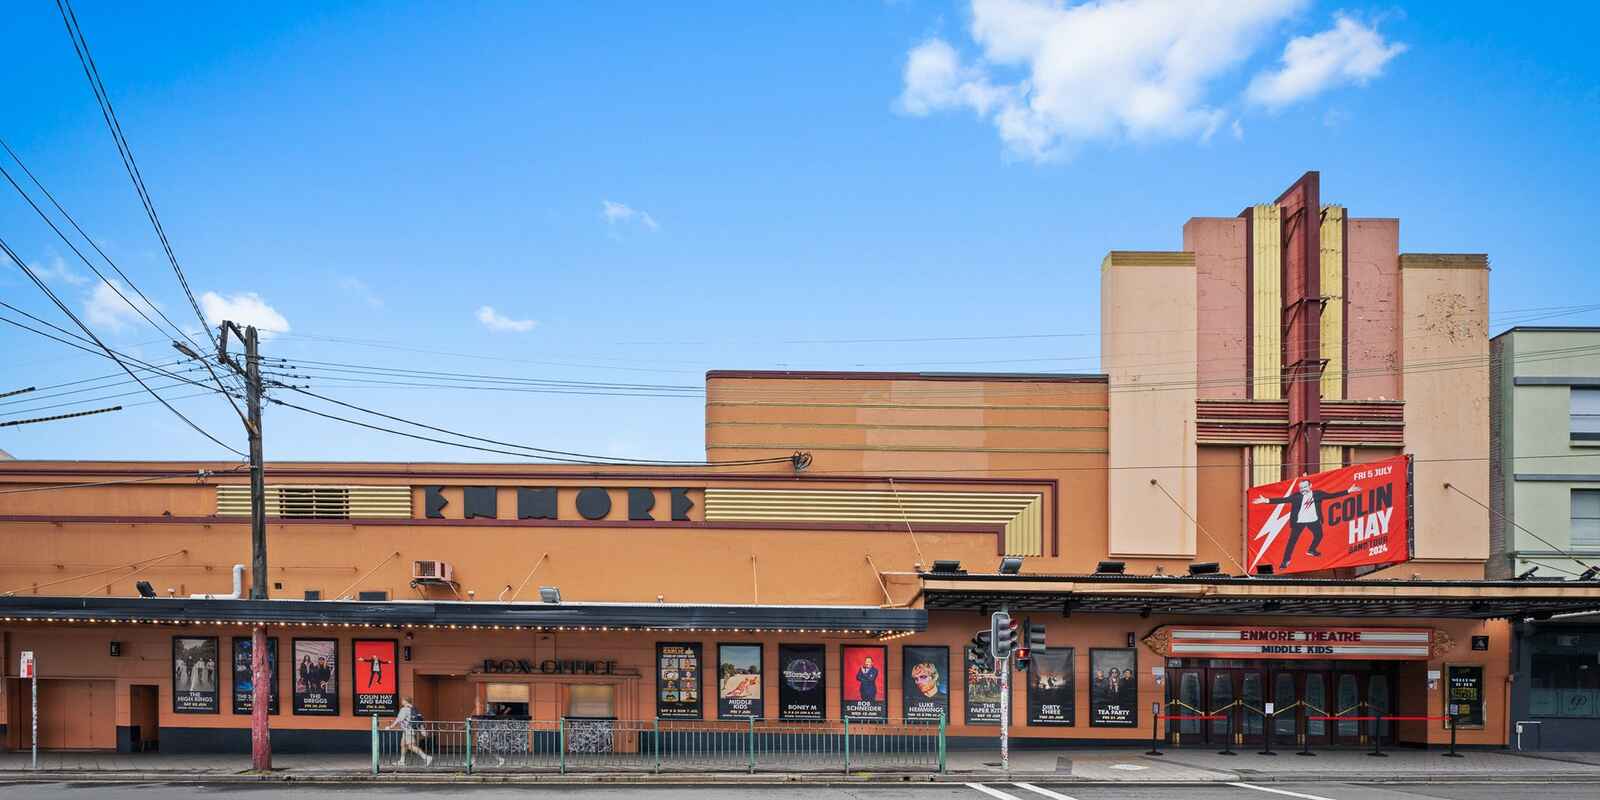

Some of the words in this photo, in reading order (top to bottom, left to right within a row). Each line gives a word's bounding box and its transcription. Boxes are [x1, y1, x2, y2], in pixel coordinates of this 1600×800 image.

[1353, 470, 1366, 480] FRI
[1374, 465, 1392, 477] JULY
[425, 485, 695, 521] ENMORE
[1328, 482, 1393, 526] COLIN
[1348, 507, 1392, 545] HAY
[1369, 544, 1388, 556] 2024
[1240, 631, 1296, 640] ENMORE
[1305, 631, 1361, 641] THEATRE
[1261, 645, 1303, 653] MIDDLE
[1307, 646, 1334, 654] KIDS
[483, 659, 530, 673] BOX
[541, 659, 617, 675] OFFICE
